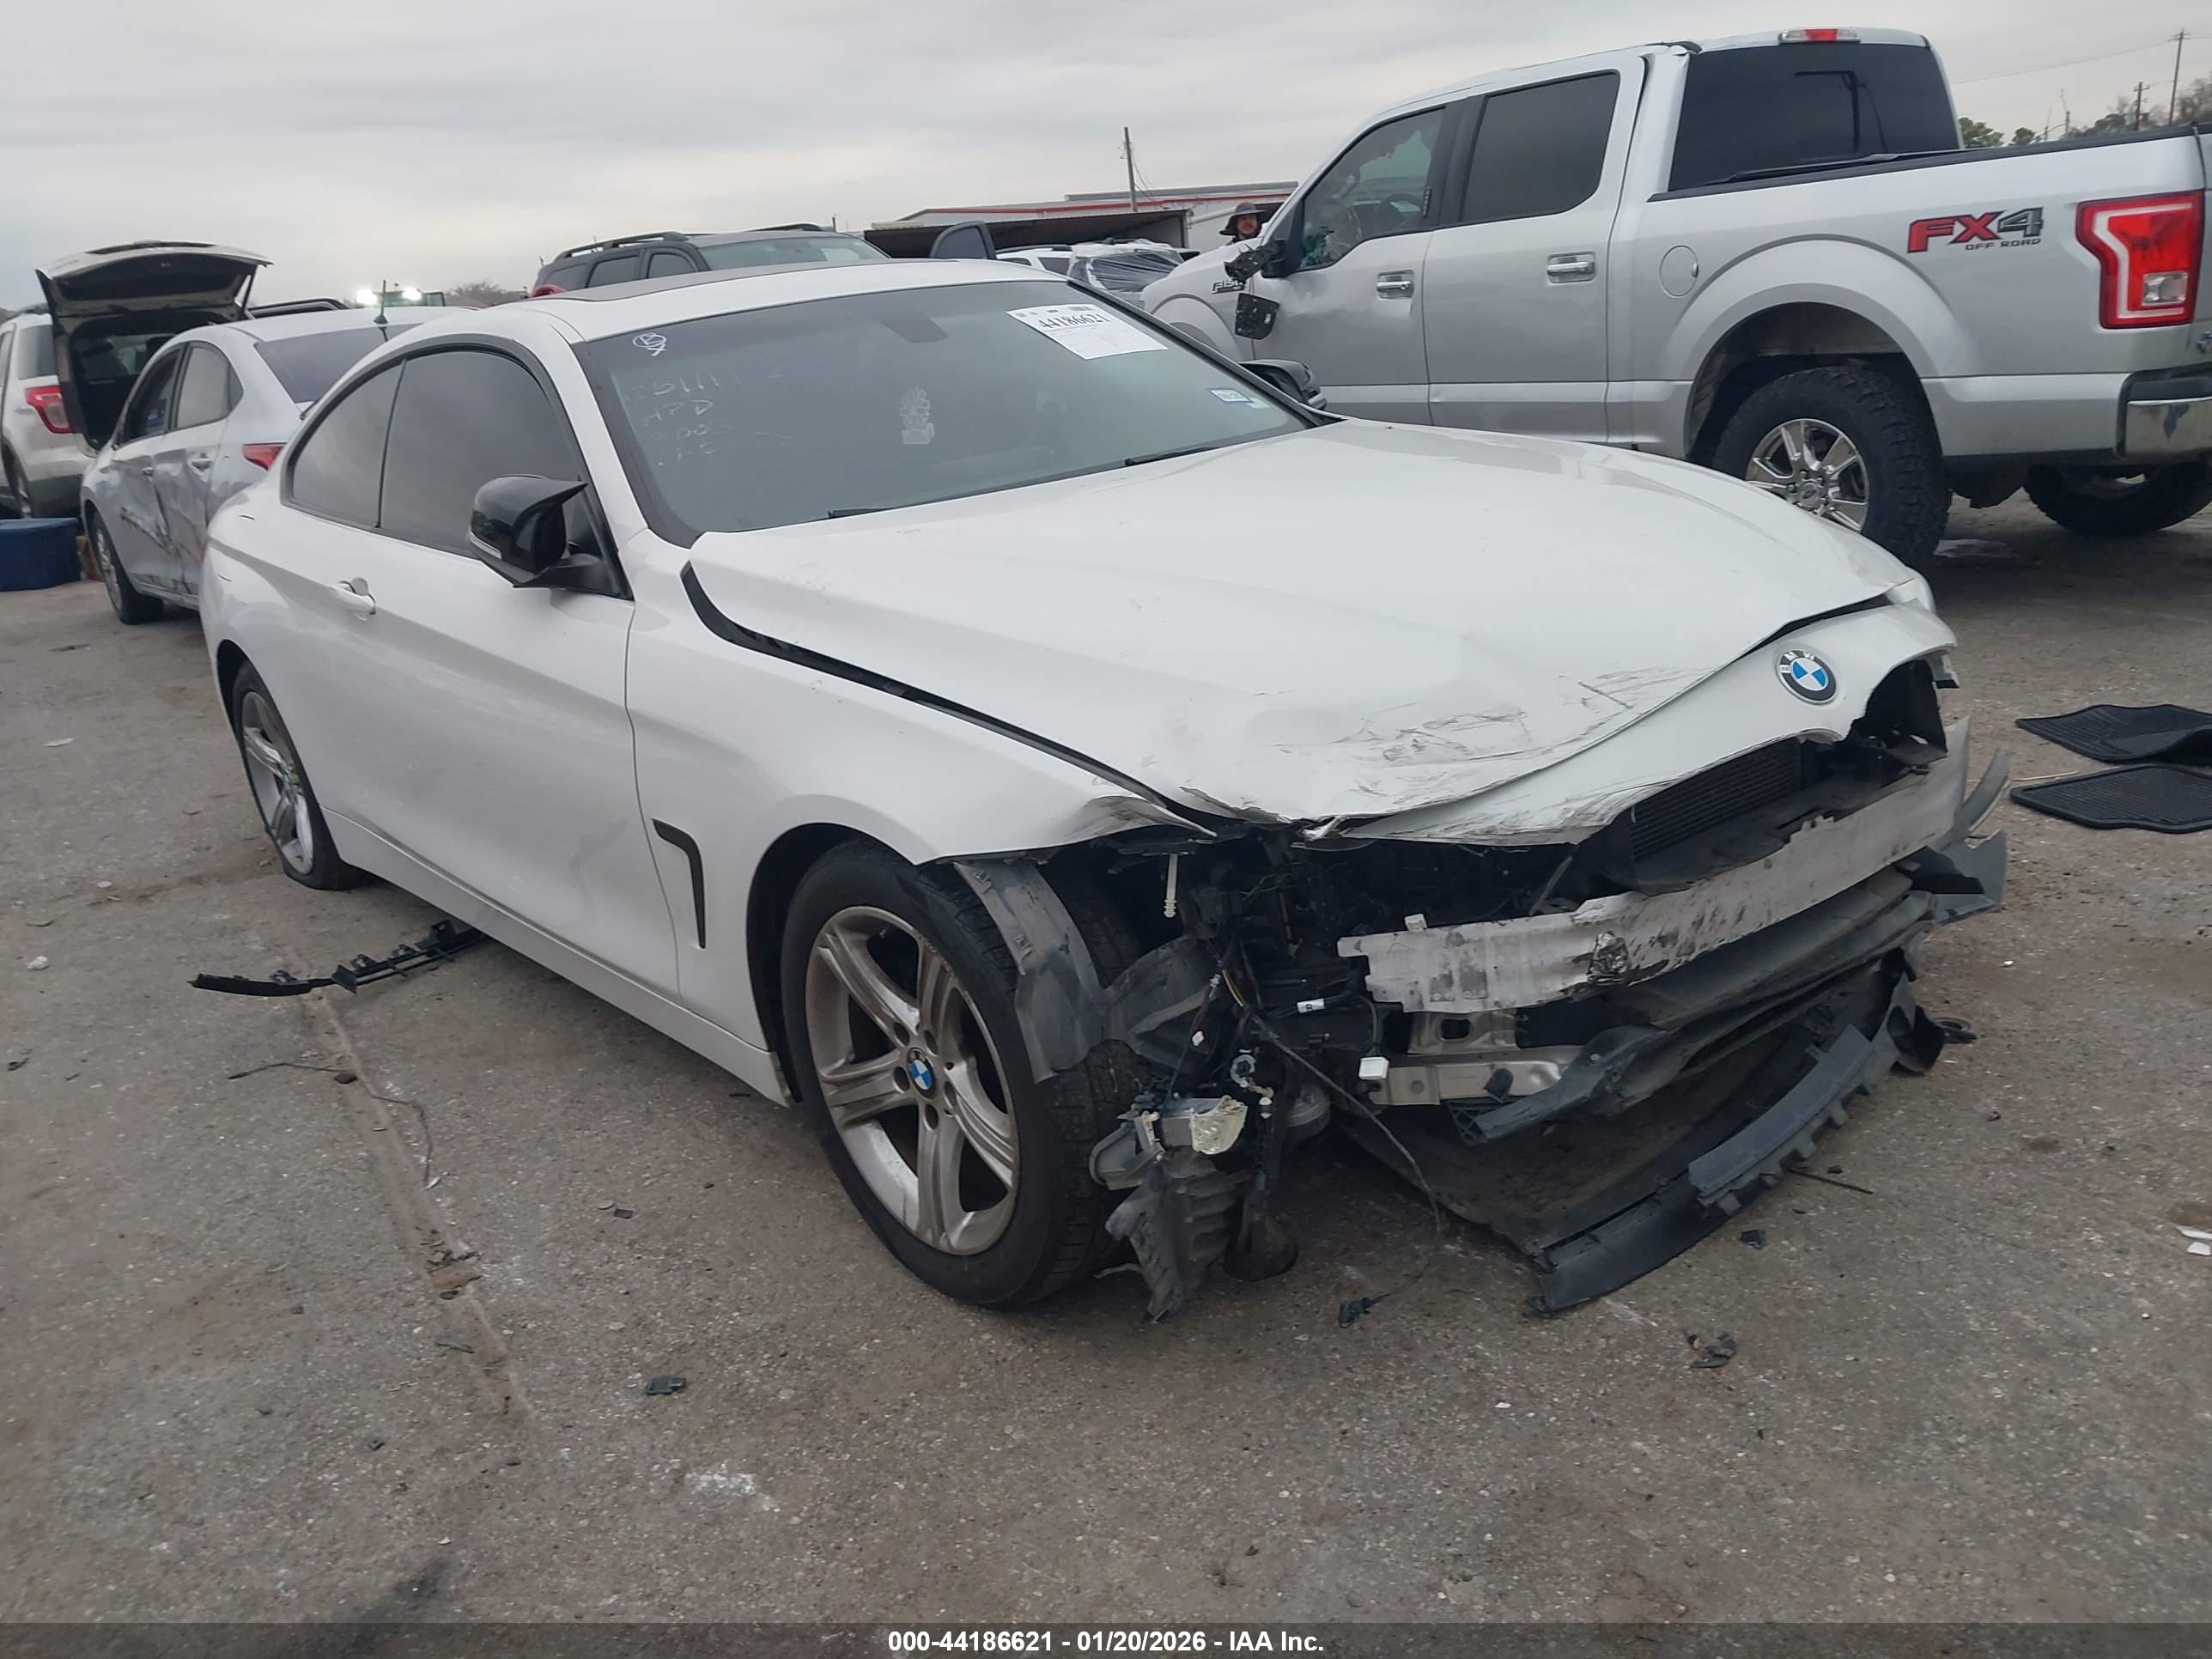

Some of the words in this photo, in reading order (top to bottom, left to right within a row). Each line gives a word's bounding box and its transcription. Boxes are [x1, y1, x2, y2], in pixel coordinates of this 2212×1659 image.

[1907, 206, 2044, 253] FX4
[1965, 242, 1996, 251] OFF
[2001, 239, 2041, 247] ROAD
[1038, 313, 1111, 329] 44186621
